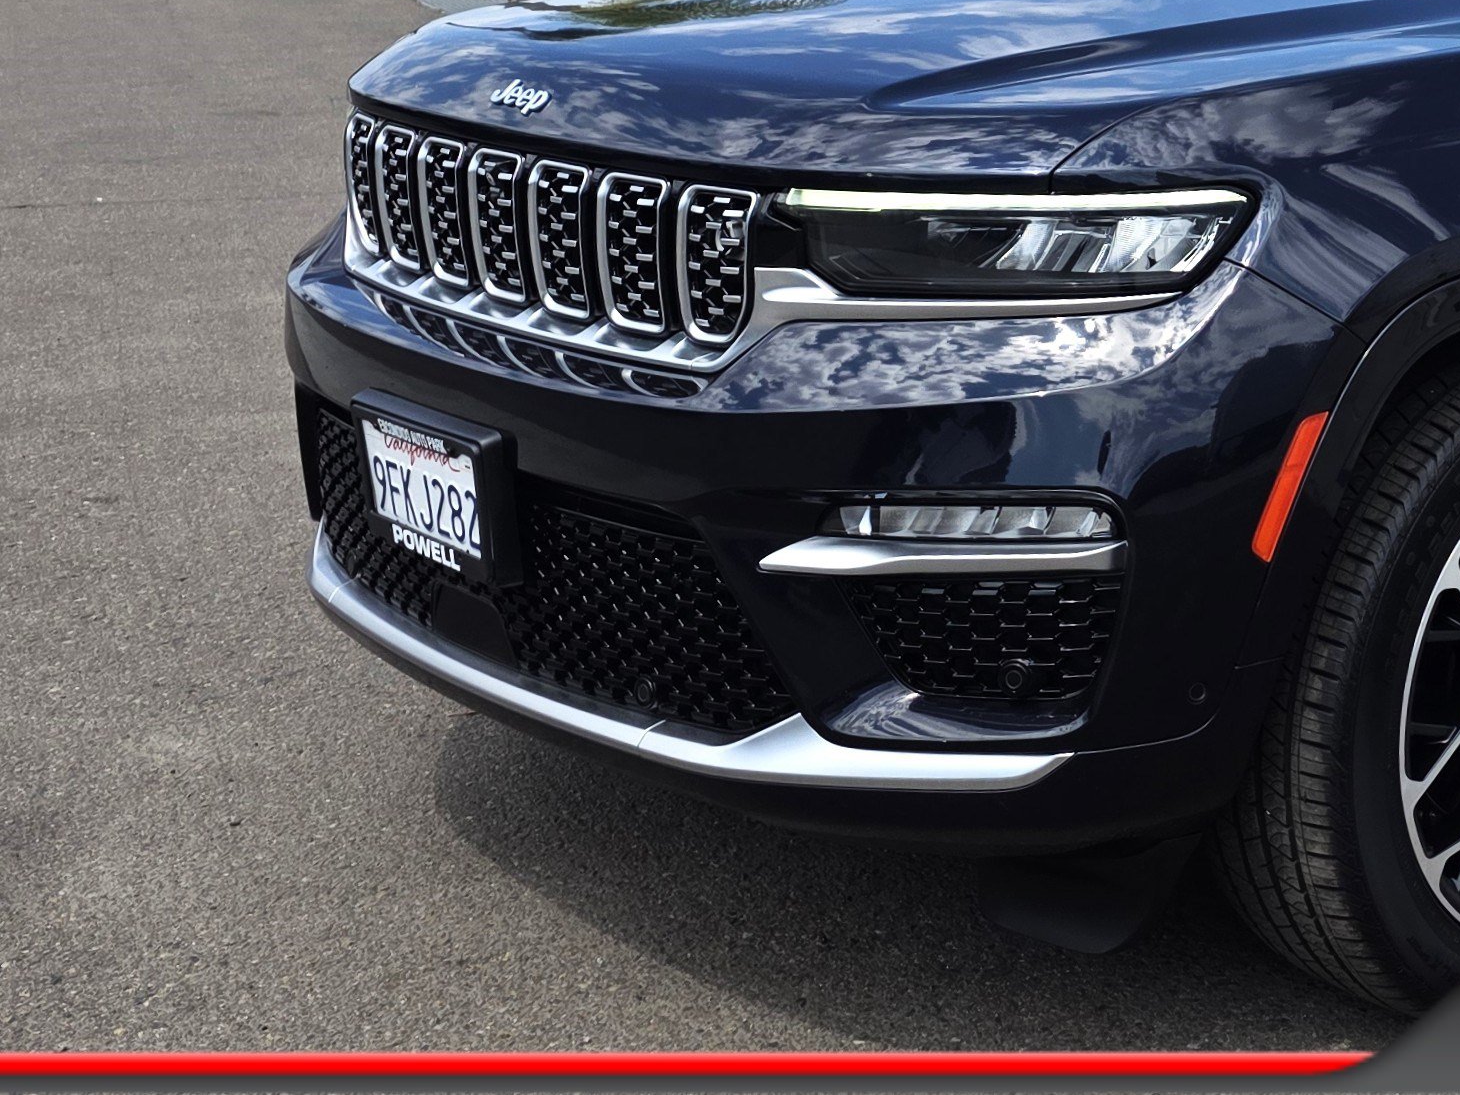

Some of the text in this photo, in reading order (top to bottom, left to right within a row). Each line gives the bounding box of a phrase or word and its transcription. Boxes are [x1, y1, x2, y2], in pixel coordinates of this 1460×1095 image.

[490, 78, 551, 116] Jeep
[373, 455, 482, 551] 9FKJ282
[391, 523, 462, 572] POWELL
